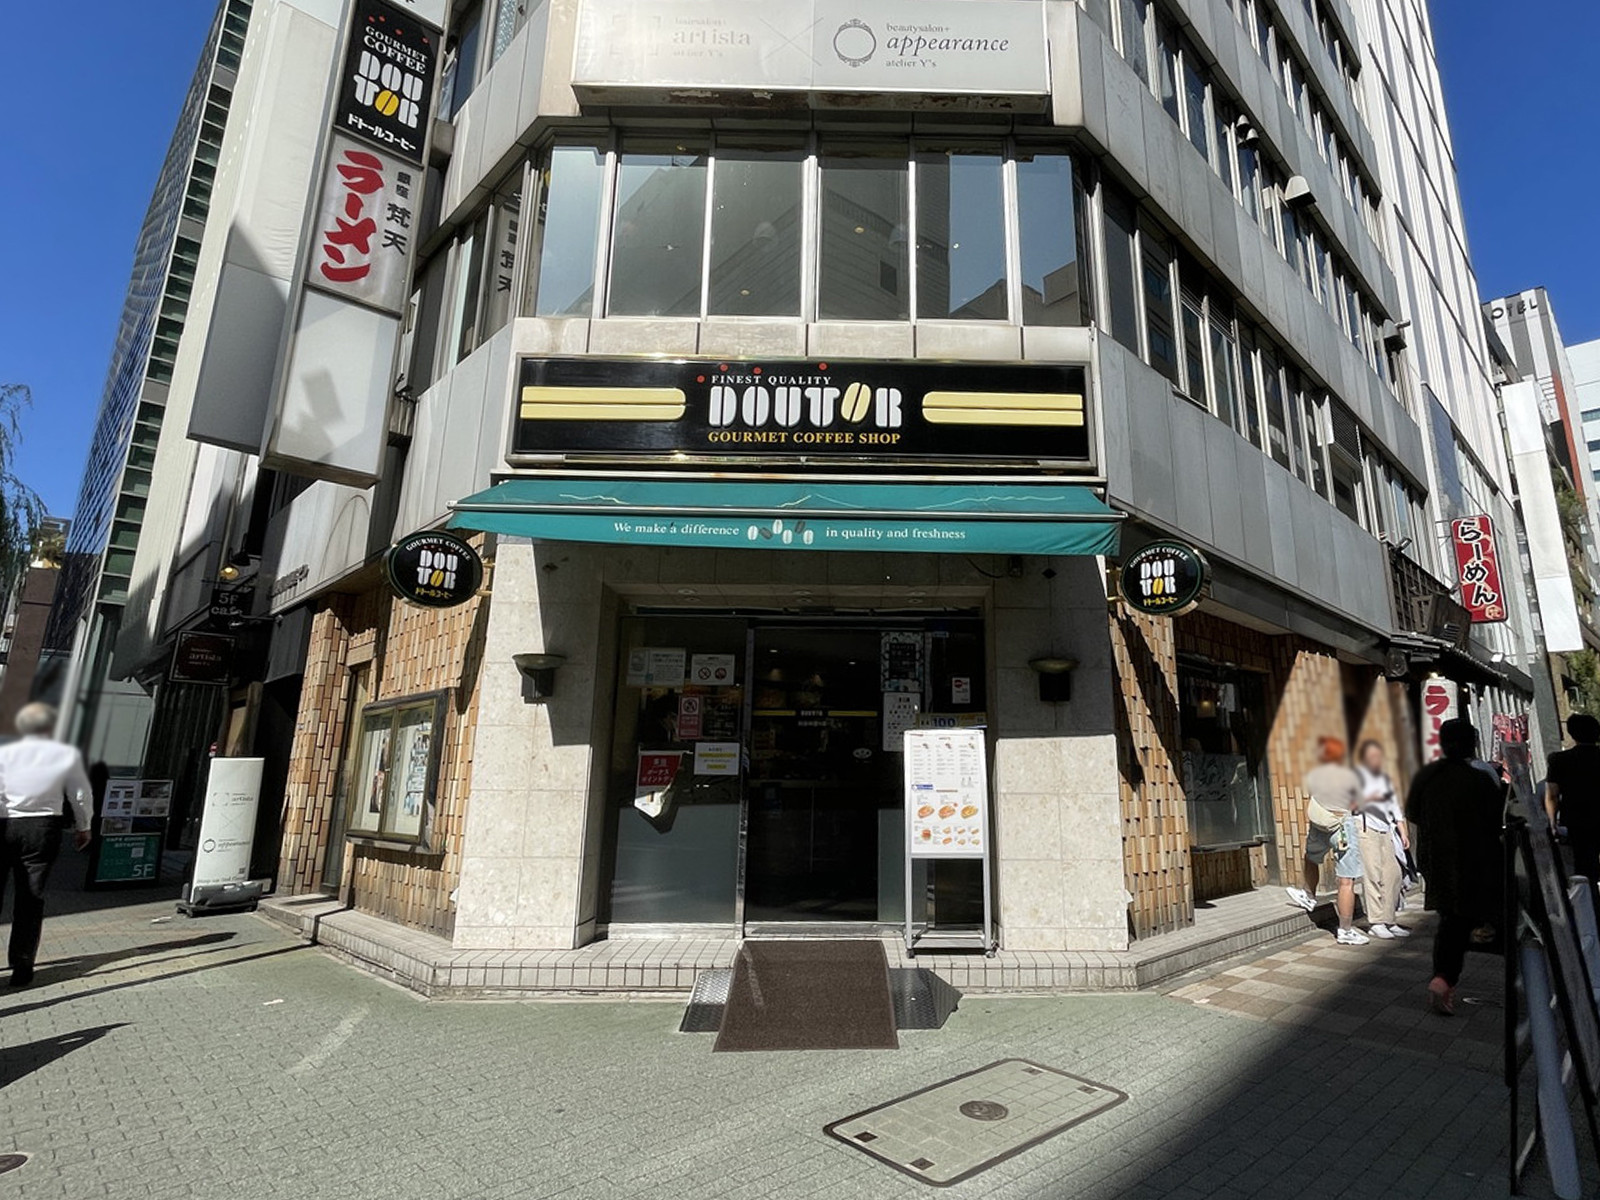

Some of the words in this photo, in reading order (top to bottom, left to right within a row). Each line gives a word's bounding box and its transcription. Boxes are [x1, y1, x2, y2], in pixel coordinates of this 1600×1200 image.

[363, 34, 426, 75] COFFEE
[365, 25, 428, 63] GOURMET
[886, 35, 1009, 57] appearance
[885, 58, 917, 68] atelier
[348, 113, 417, 151] ドトールコーヒー
[320, 150, 385, 282] ラーメン
[1491, 298, 1538, 320] OTEL
[711, 375, 762, 385] FINEST
[768, 375, 832, 385] QUALITY
[708, 381, 903, 428] DOUTOR
[708, 431, 789, 443] GOURMET
[792, 432, 855, 444] COFFEE
[858, 432, 901, 444] SHOP
[614, 522, 632, 533] We
[635, 523, 667, 534] make
[669, 525, 677, 534] a
[680, 523, 740, 536] difference
[826, 526, 838, 537] in
[841, 527, 884, 540] quality
[886, 527, 909, 539] and
[912, 527, 966, 539] freshness
[407, 538, 443, 550] GOURMET
[446, 542, 471, 560] COFFEE
[1459, 518, 1497, 607] らーめん
[131, 863, 154, 878] 5F
